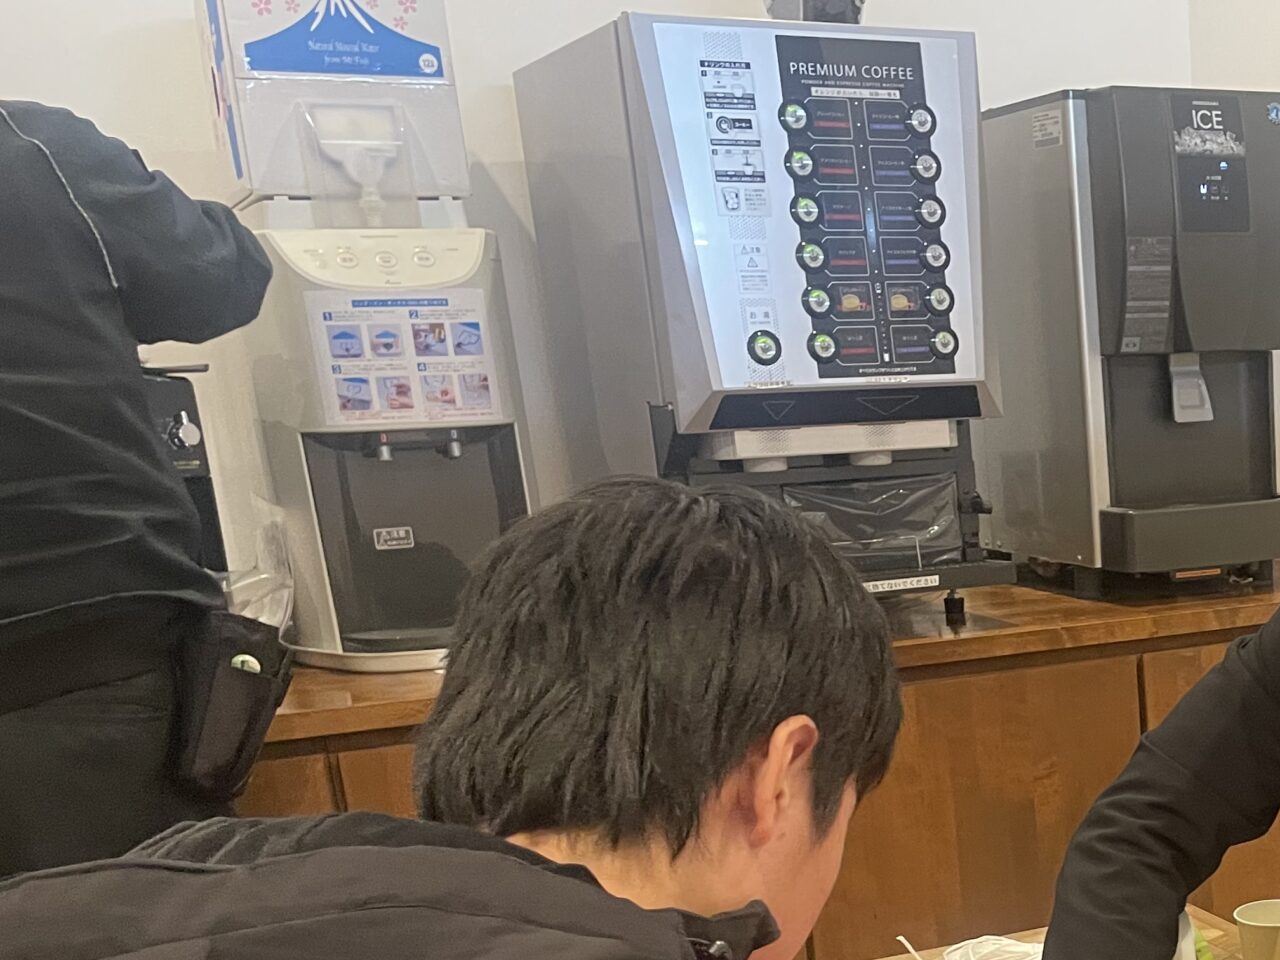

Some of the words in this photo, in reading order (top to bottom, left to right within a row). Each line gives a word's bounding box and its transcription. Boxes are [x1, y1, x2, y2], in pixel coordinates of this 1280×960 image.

[789, 62, 857, 78] PREMIUM
[861, 65, 914, 80] COFFEE
[1191, 109, 1224, 129] ICE
